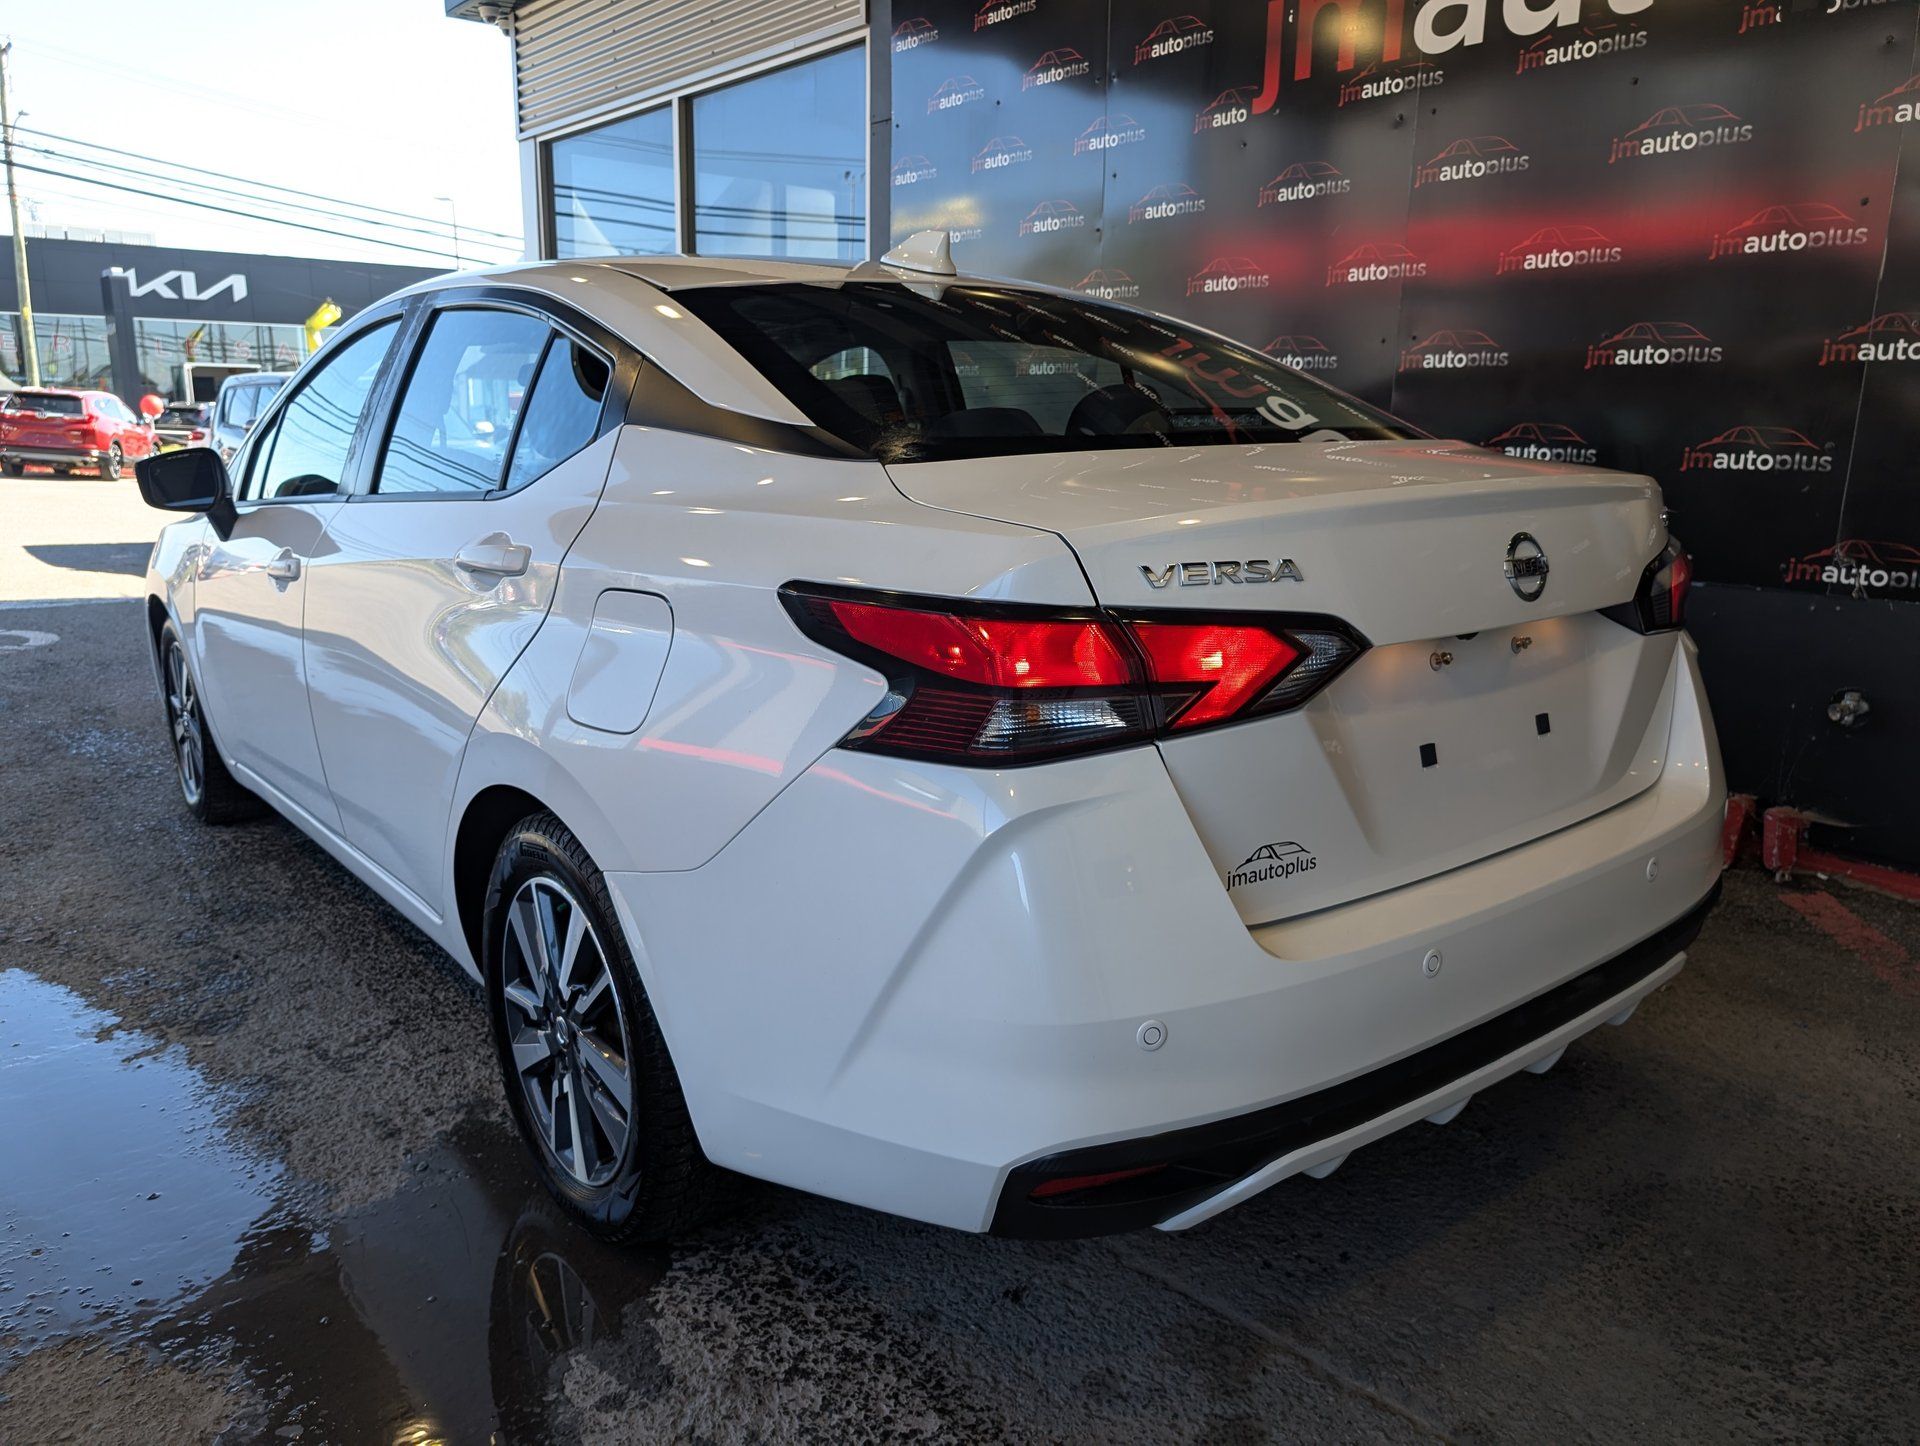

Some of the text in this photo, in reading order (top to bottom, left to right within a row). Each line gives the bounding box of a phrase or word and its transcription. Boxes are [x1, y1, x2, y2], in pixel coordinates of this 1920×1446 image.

[973, 0, 1037, 32] jmautoplus
[891, 29, 939, 53] autoplus
[1133, 28, 1215, 66] jmautoplus
[1516, 28, 1648, 75] jmautoplus
[1021, 61, 1090, 92] jmautoplus
[1338, 68, 1444, 108] jmautoplus
[927, 88, 985, 115] jmautoplus
[1193, 107, 1248, 135] jmauto
[1073, 127, 1146, 156] jmautoplus
[1608, 124, 1753, 164] jmautoplus
[971, 149, 1032, 175] jmautoplus
[1414, 153, 1530, 188] jmautoplus
[1257, 178, 1351, 208] jmautoplus
[1018, 214, 1085, 238] jmautoplus
[1128, 198, 1206, 225] jmautoplus
[1708, 226, 1869, 261] jmautoplus
[1325, 261, 1428, 287] jmautoplus
[1496, 246, 1622, 275] jmautoplus
[124, 267, 248, 303] KIA
[1185, 274, 1270, 297] jmautoplus
[1398, 349, 1509, 372] jmautoplus
[1584, 343, 1723, 370] jmautoplus
[1680, 446, 1833, 472] jmautoplus
[1137, 558, 1304, 589] VERSA
[1513, 558, 1547, 577] NISSAN
[1226, 856, 1317, 892] jmautoplus
